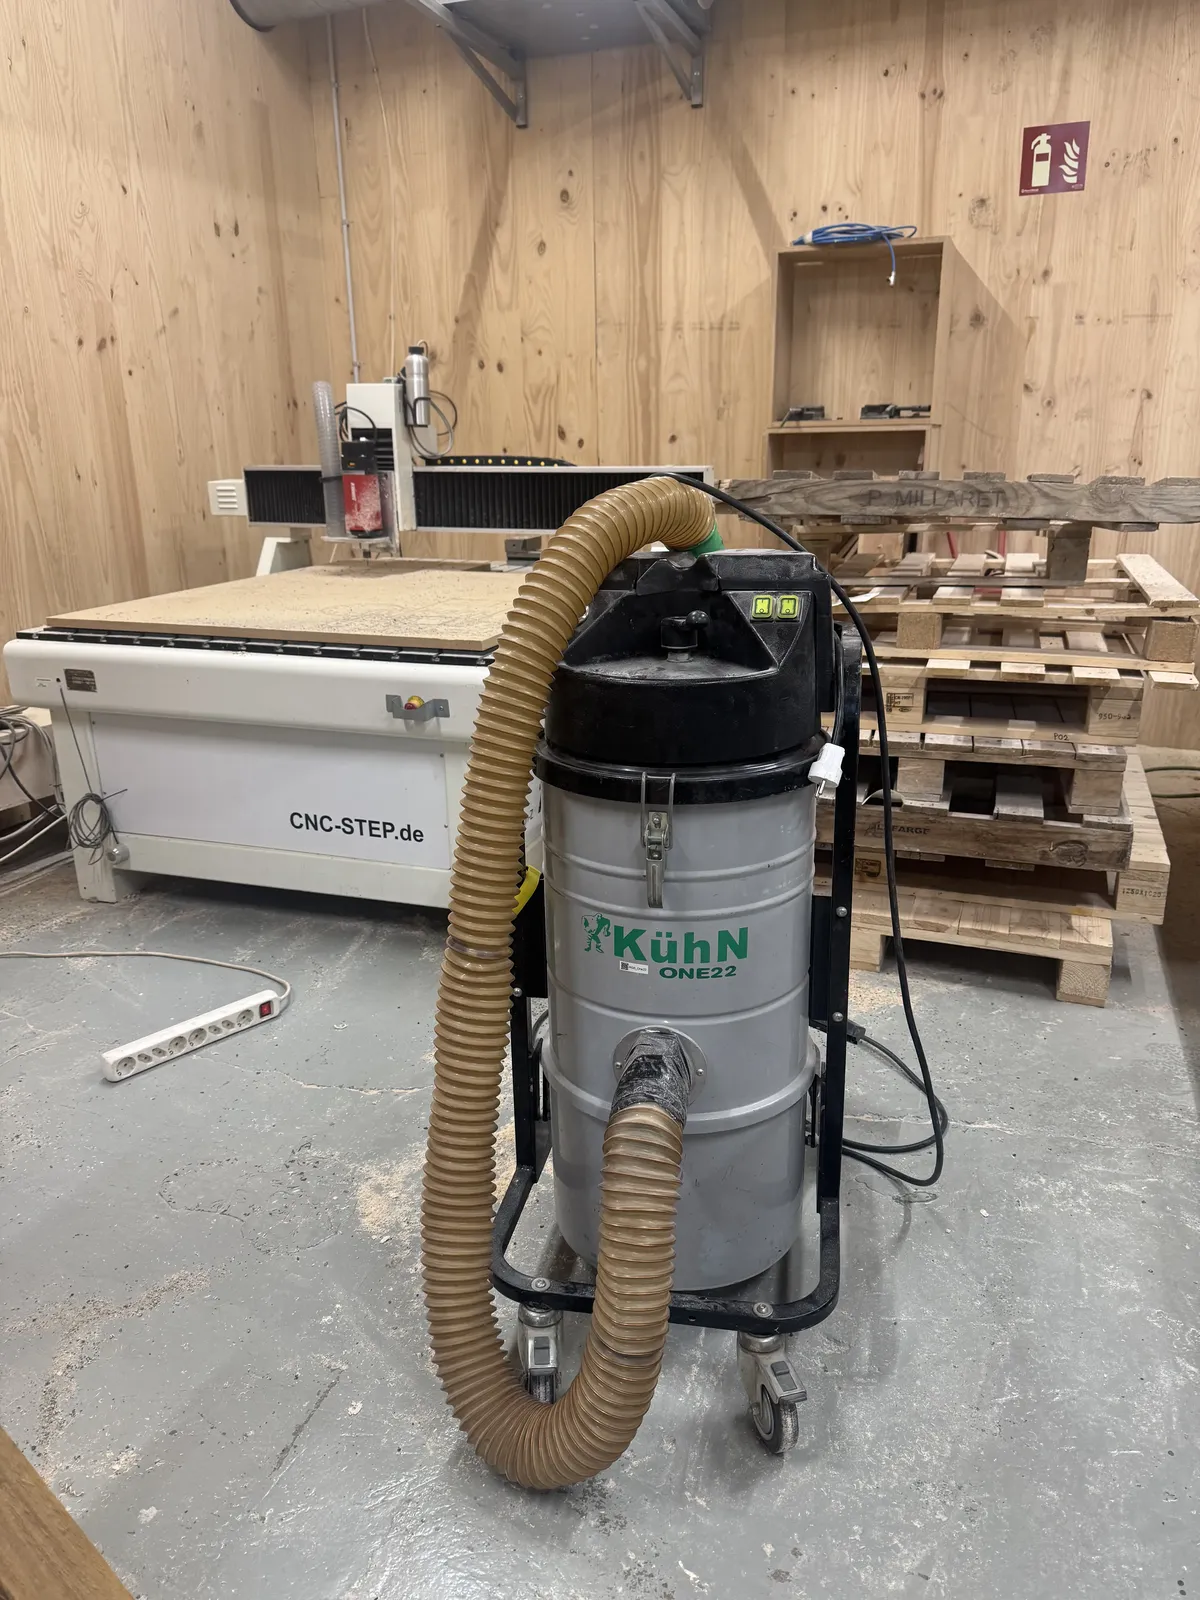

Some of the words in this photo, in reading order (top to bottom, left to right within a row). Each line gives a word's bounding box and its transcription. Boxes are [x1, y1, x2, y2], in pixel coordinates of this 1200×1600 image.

[896, 488, 1006, 508] MILLARET
[290, 812, 424, 843] CNC-STEP.de
[877, 823, 931, 835] LFARGE
[614, 925, 749, 964] KühN
[659, 965, 737, 979] ONE22
